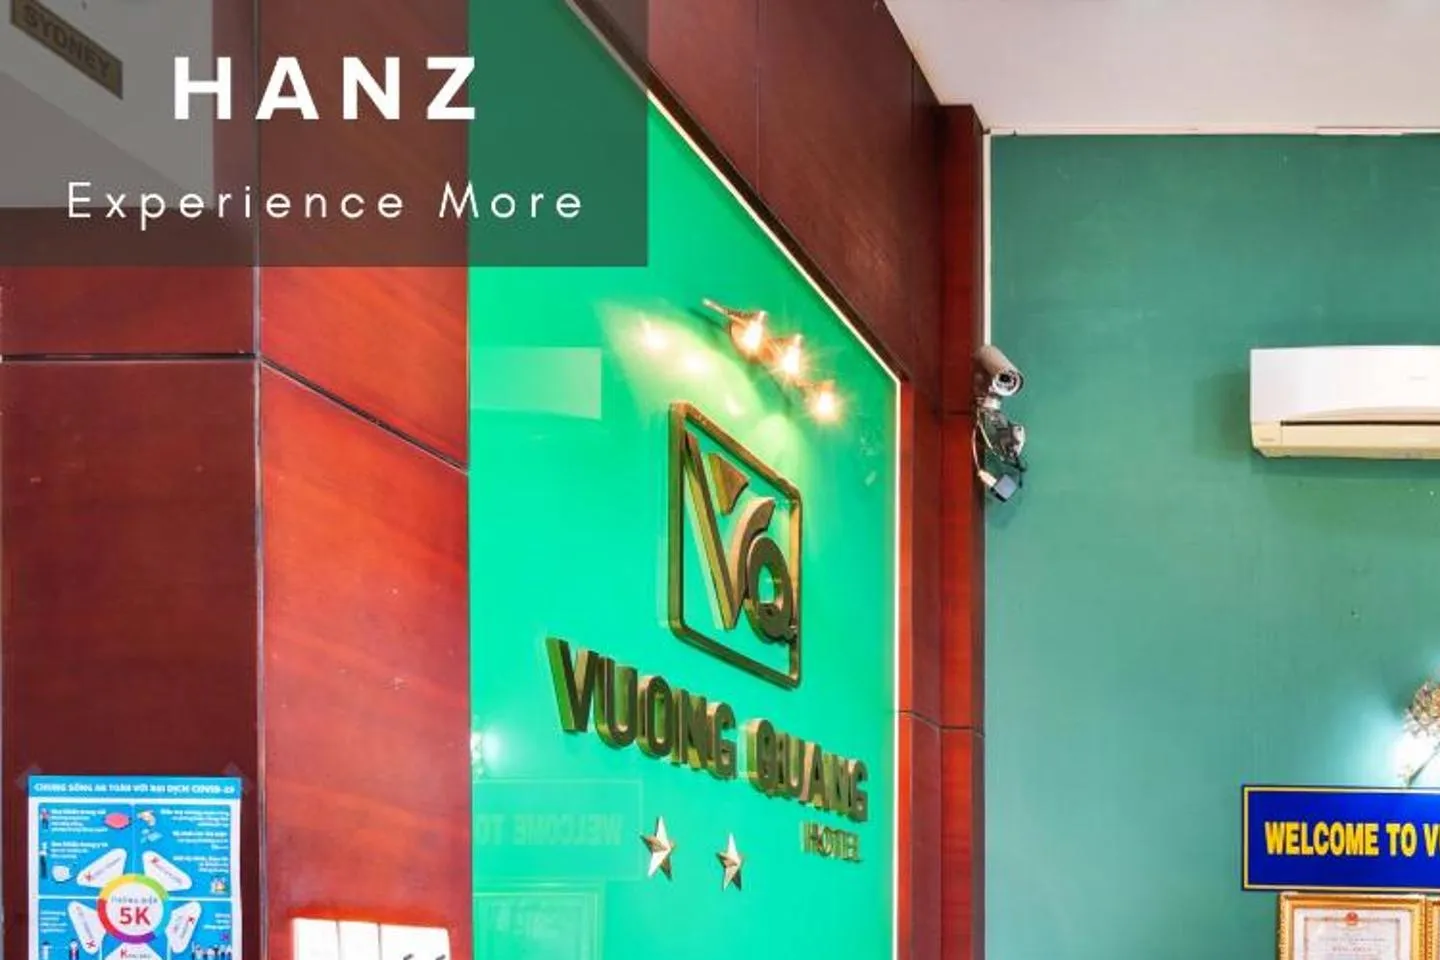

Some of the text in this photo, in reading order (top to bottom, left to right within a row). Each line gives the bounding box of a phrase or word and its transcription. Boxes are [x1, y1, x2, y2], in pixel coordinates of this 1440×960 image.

[24, 4, 110, 79] SYDNEY
[545, 637, 869, 823] VUONG QUANG
[802, 820, 862, 863] HOTEL
[1264, 821, 1379, 856] WELCOME
[1386, 822, 1418, 857] TO
[119, 906, 151, 926] 5K
